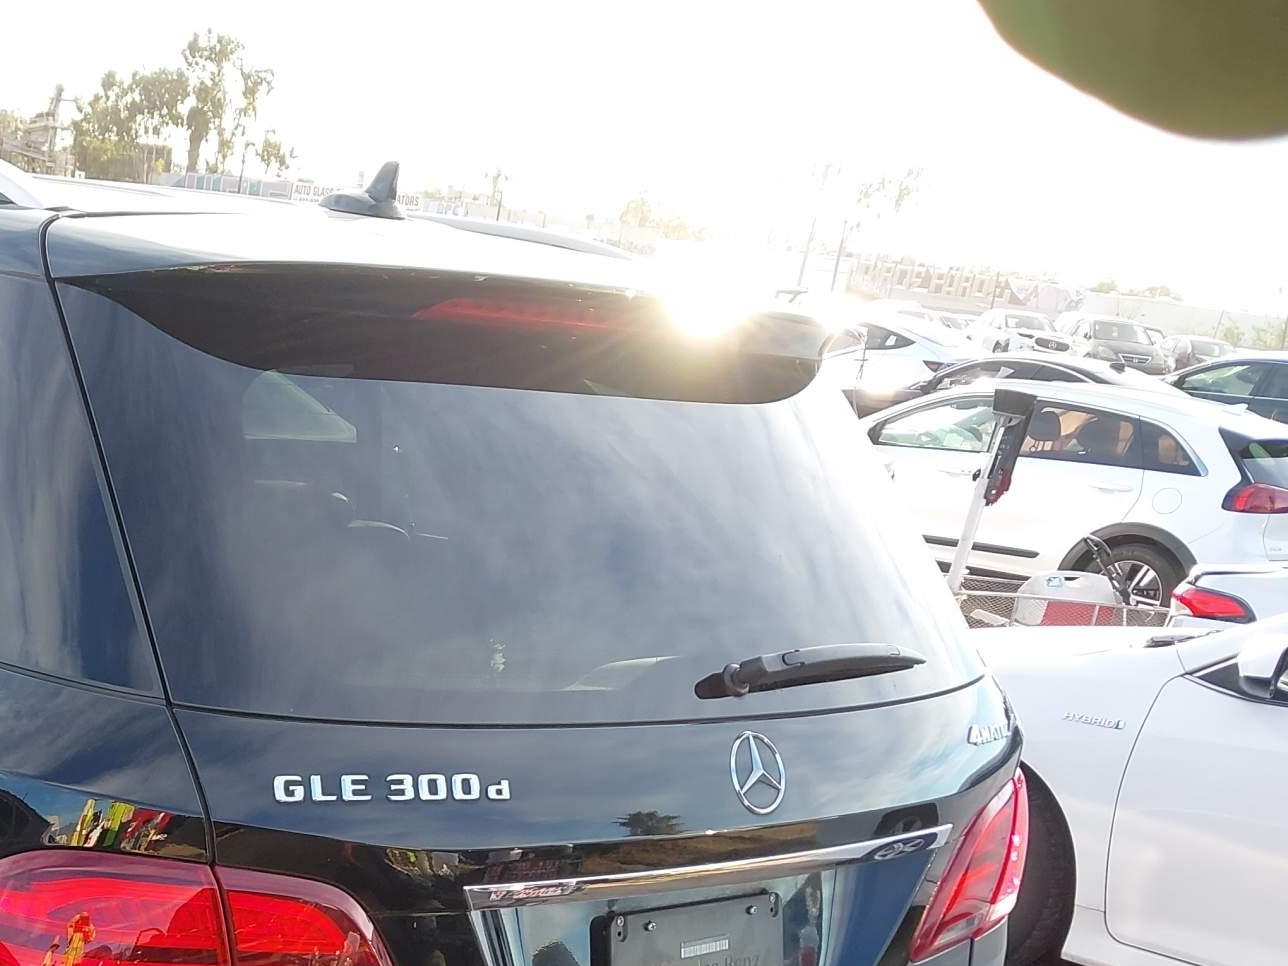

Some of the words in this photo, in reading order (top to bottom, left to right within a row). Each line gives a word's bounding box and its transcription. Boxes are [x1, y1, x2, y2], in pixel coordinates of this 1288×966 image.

[294, 184, 311, 196] AUTO
[1062, 711, 1116, 729] HYBRID
[273, 774, 373, 802] GLE
